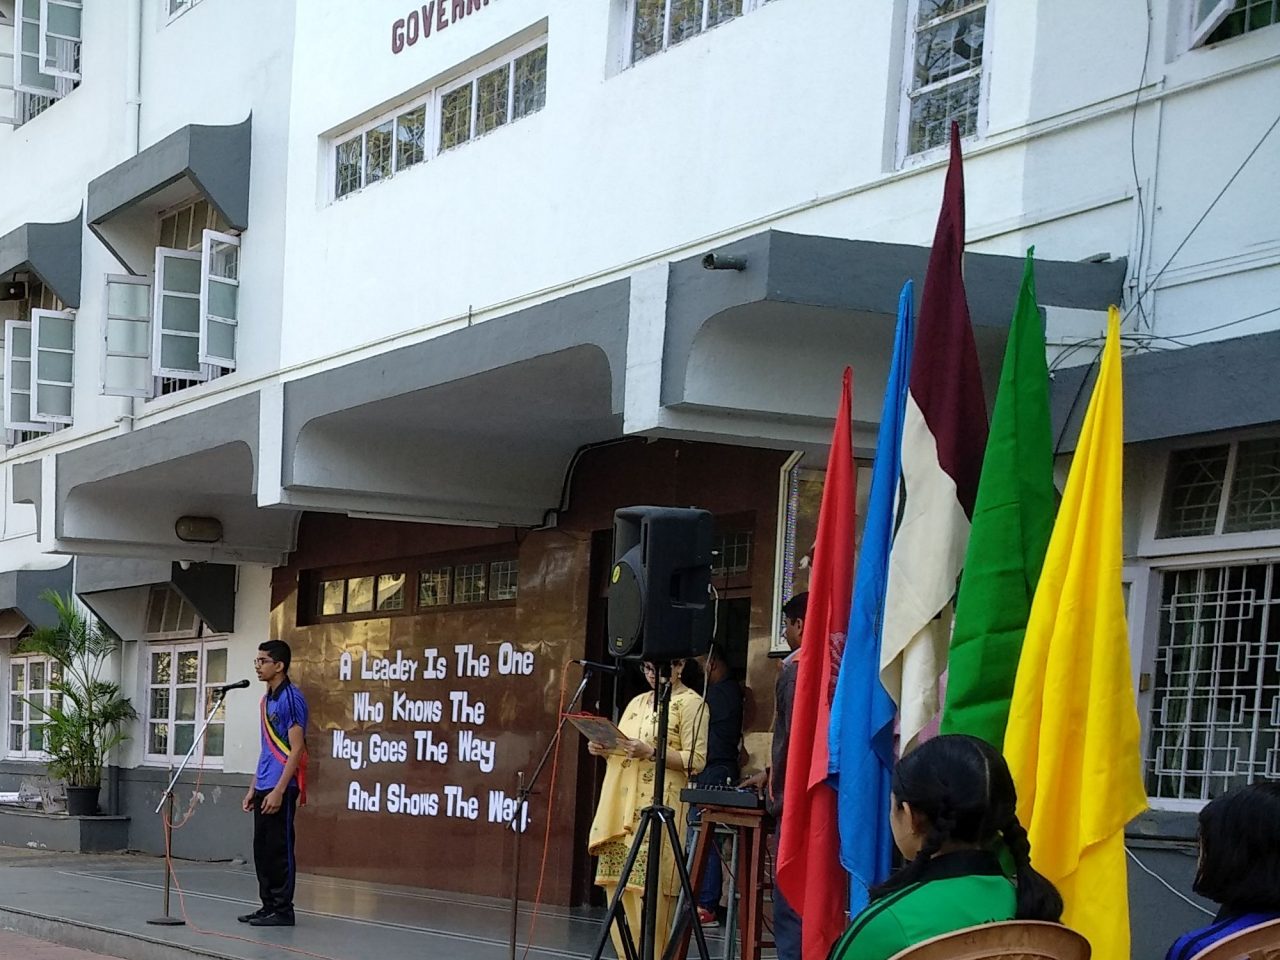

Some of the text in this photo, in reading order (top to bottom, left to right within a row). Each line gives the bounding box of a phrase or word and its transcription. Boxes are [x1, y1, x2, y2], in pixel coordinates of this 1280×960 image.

[391, 0, 489, 54] GOVER
[339, 642, 534, 682] A Leader Is The One
[353, 691, 485, 725] Who Knows The
[369, 733, 407, 763] Goes
[414, 730, 448, 764] The
[458, 730, 496, 773] Way
[347, 781, 381, 812] And
[387, 783, 439, 816] Shows
[444, 785, 479, 820] The
